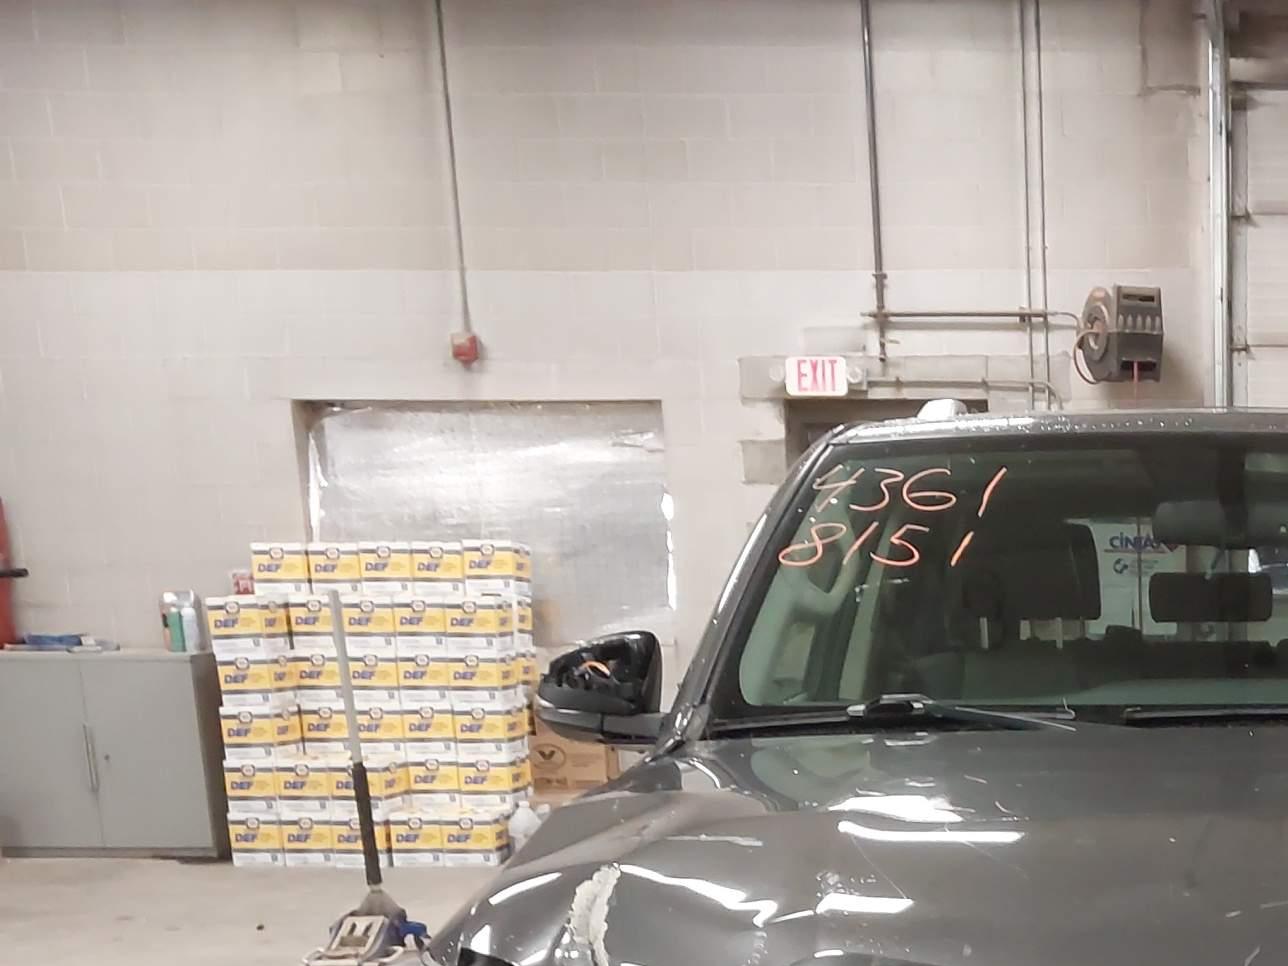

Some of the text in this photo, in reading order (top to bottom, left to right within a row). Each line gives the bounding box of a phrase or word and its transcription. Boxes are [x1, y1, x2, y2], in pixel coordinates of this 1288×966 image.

[797, 359, 837, 392] EXIT
[812, 464, 1008, 517] 4361
[778, 521, 976, 567] 8151
[258, 563, 281, 573] DEF
[314, 563, 337, 573] DEF
[365, 562, 388, 571] DEF
[418, 562, 440, 572] DEF
[469, 560, 491, 569] DEF
[214, 619, 238, 628] DEF
[295, 617, 318, 626] DEF
[349, 617, 371, 625] DEF
[401, 617, 423, 625] DEF
[451, 617, 473, 626] DEF
[225, 674, 247, 683] DEF
[300, 671, 321, 679] DEF
[352, 671, 375, 680] DEF
[404, 671, 426, 680] DEF
[454, 671, 476, 680] DEF
[308, 724, 330, 732] DEF
[359, 724, 381, 732] DEF
[410, 723, 432, 732] DEF
[461, 723, 482, 732] DEF
[228, 728, 250, 737] DEF
[415, 775, 436, 784] DEF
[465, 776, 487, 785] DEF
[231, 781, 253, 790] DEF
[284, 780, 306, 789] DEF
[336, 780, 353, 790] DE
[235, 834, 257, 843] DEF
[287, 834, 309, 843] DEF
[397, 833, 419, 843] DEF
[448, 834, 470, 843] DEF
